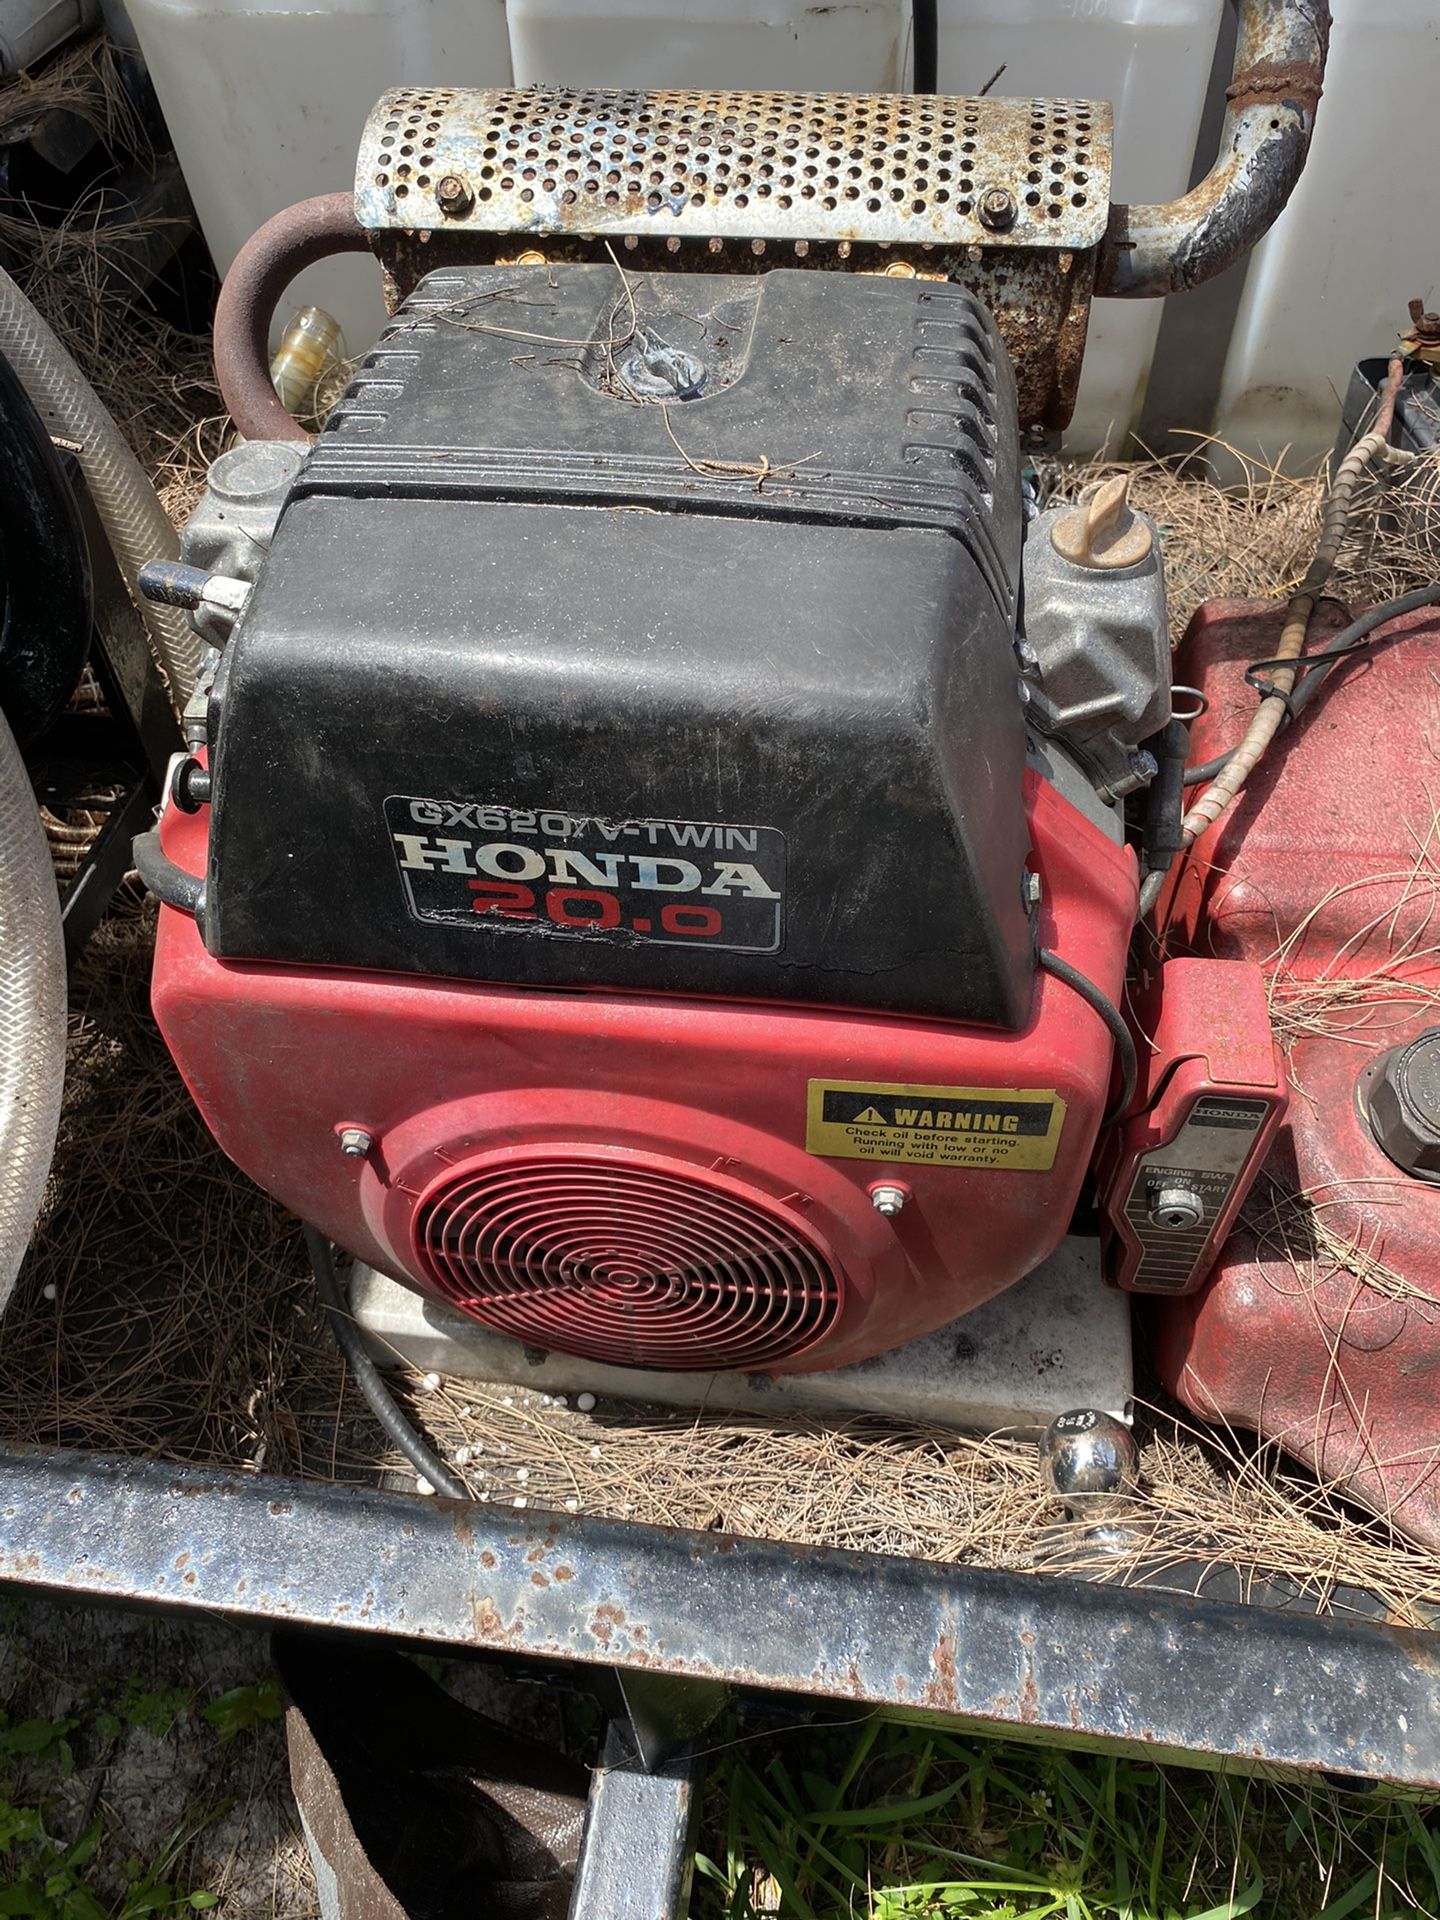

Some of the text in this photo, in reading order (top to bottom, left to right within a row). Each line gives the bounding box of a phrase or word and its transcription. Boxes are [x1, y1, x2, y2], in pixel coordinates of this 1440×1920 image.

[393, 832, 782, 900] HONDA
[467, 879, 723, 937] 20.0
[894, 1108, 1020, 1132] WARNING
[1194, 1108, 1260, 1120] HONDA
[845, 1126, 1020, 1148] Check oil before starting.
[853, 1136, 905, 1150] Running
[911, 1142, 938, 1151] with
[943, 1144, 967, 1153] low
[972, 1146, 987, 1154] or
[859, 1146, 999, 1164] oil will void warranty.
[1145, 1166, 1196, 1178] ENGINE
[1174, 1177, 1192, 1185] ON
[1147, 1179, 1169, 1189] OFF
[1190, 1183, 1227, 1194] START
